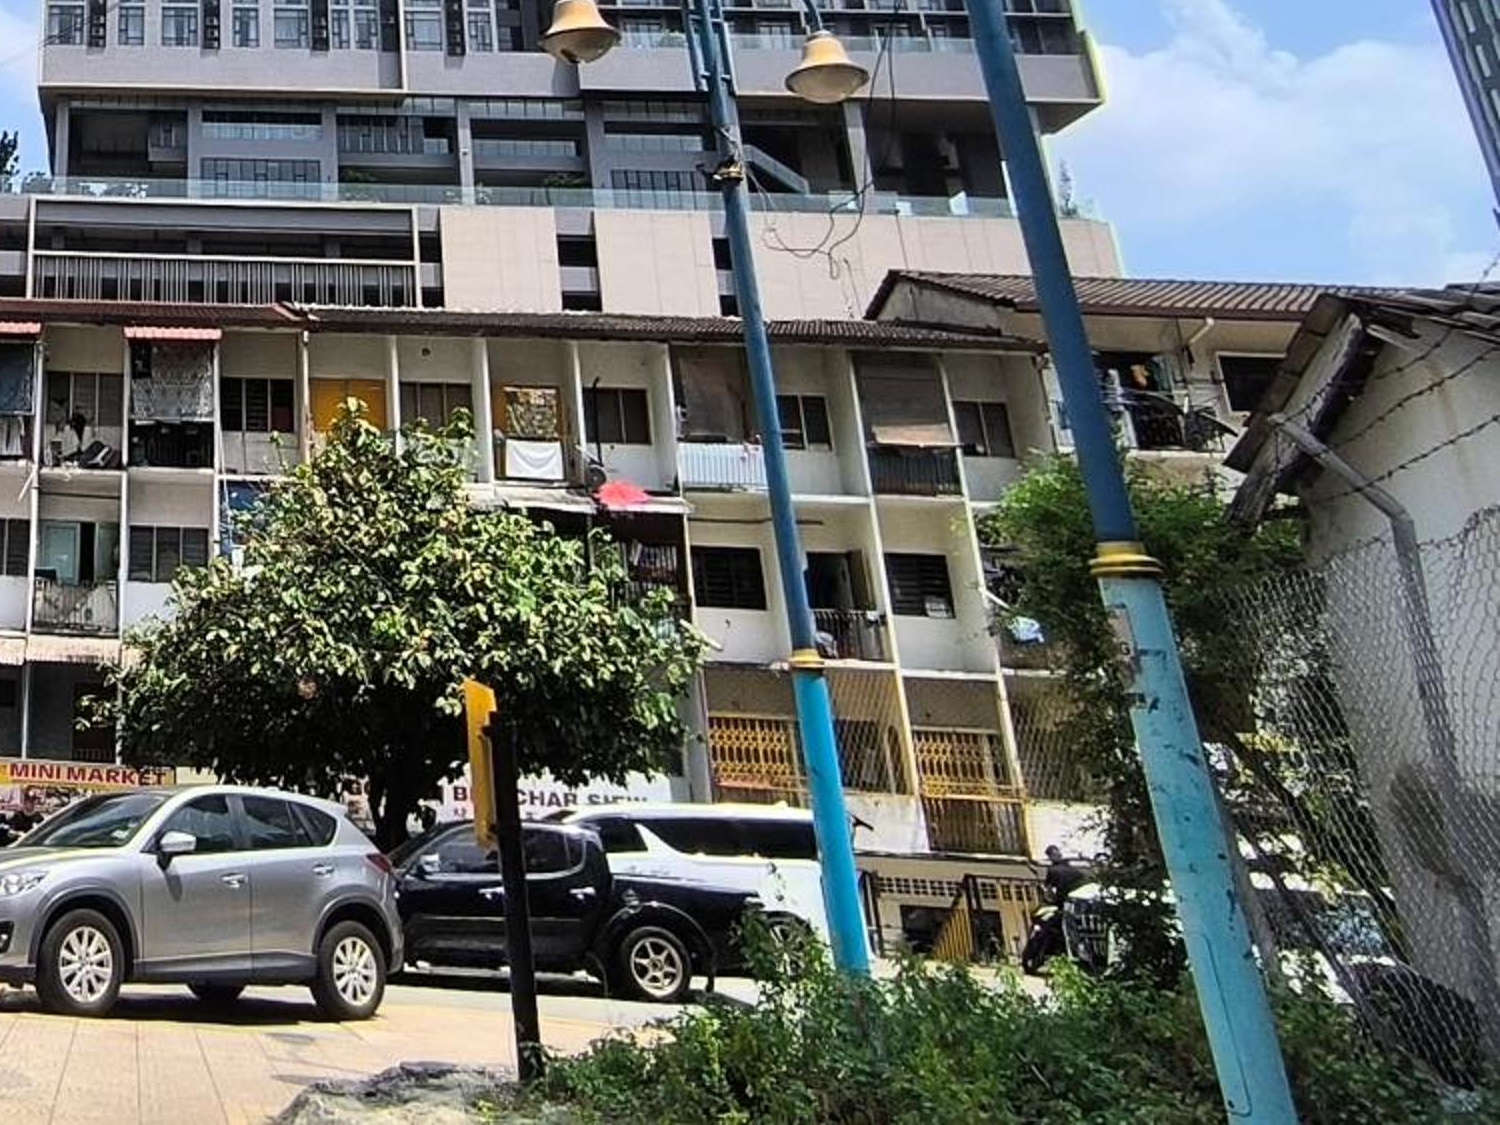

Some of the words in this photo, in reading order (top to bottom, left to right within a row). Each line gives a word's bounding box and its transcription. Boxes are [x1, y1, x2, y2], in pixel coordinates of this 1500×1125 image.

[10, 762, 61, 781] MINI
[66, 766, 167, 786] MARKET
[516, 788, 577, 808] CHAR
